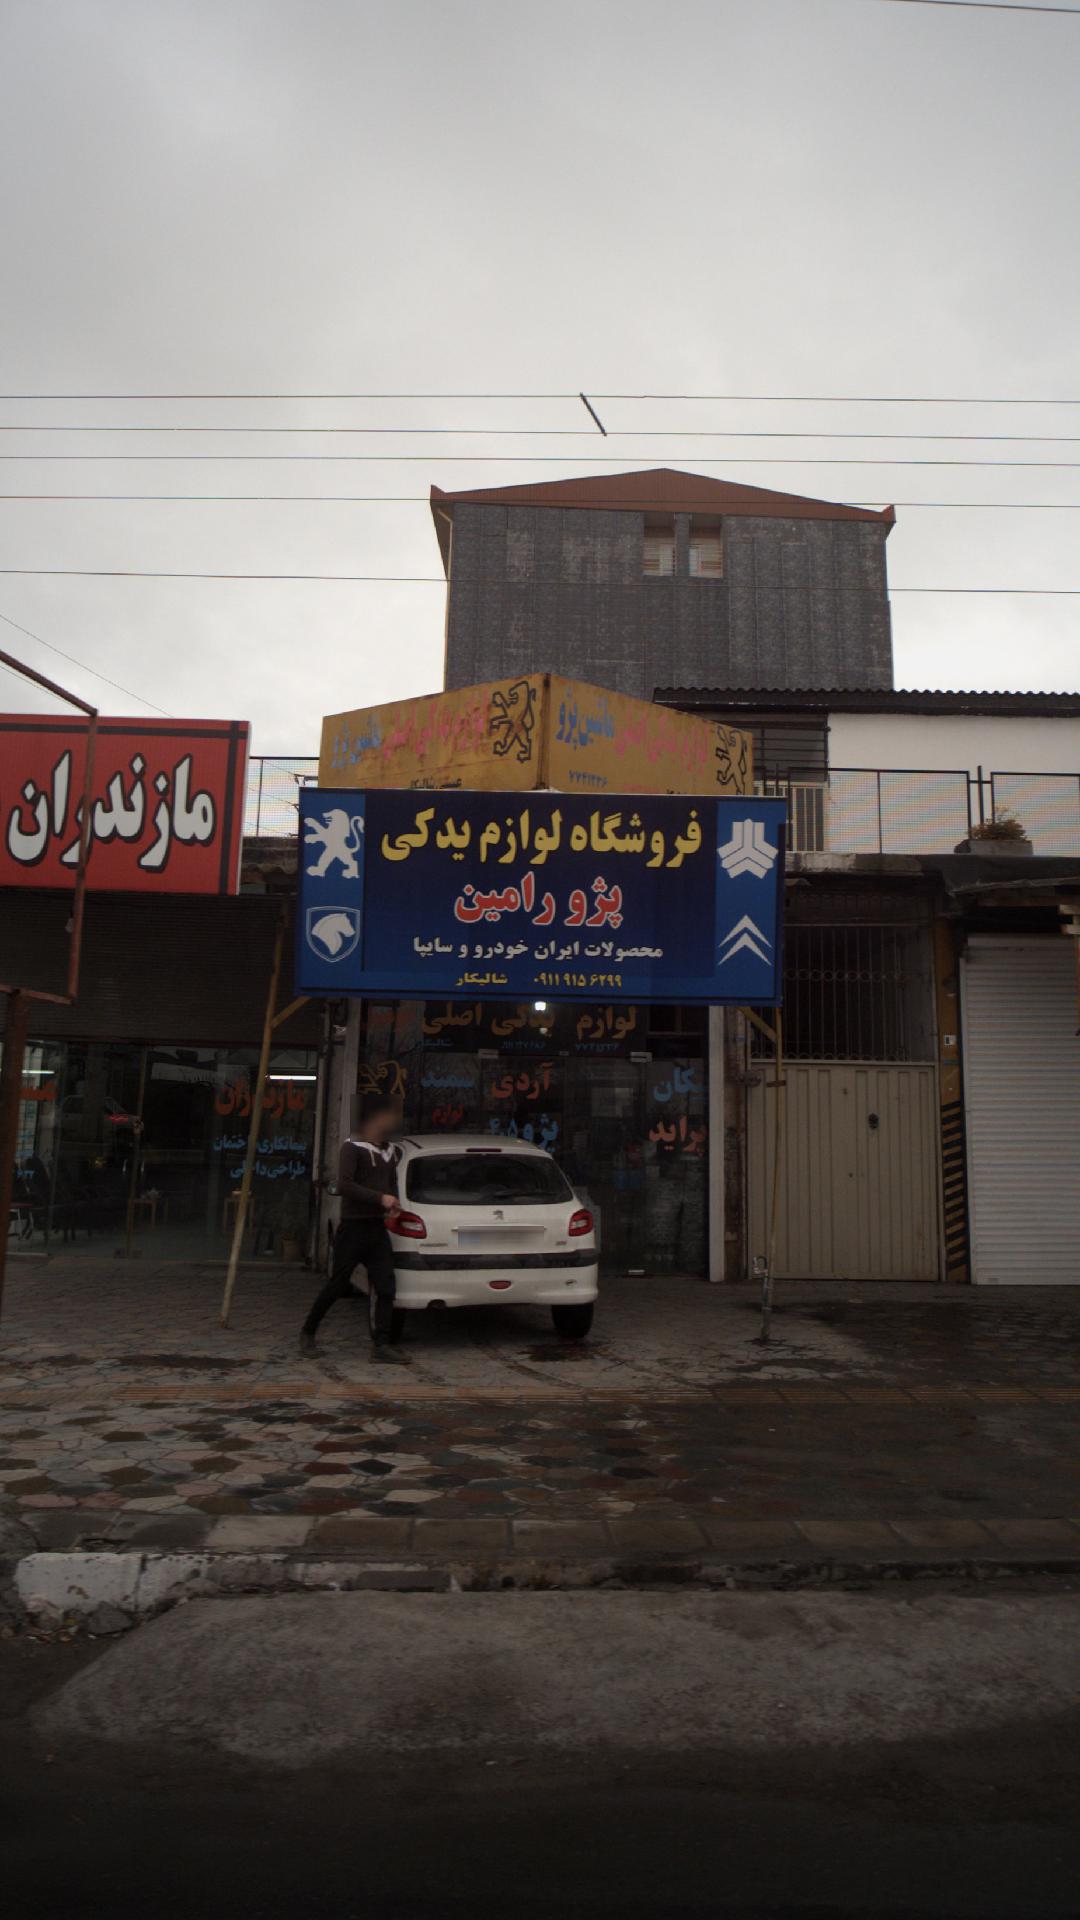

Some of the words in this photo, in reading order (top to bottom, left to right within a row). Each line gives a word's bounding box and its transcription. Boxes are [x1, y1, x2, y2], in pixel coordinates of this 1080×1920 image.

[7, 749, 218, 873] مازندران
[381, 807, 472, 861] یدکی
[479, 809, 563, 864] لوازم
[570, 808, 703, 868] فروشگاه
[453, 870, 556, 926] رامین
[564, 875, 624, 929] پژو
[412, 936, 453, 958] سایپا
[458, 942, 468, 959] و
[473, 938, 529, 960] خودرو
[533, 940, 580, 961] ایران
[583, 940, 664, 962] محصولات
[455, 973, 509, 987] شالیکار
[533, 972, 560, 987] ۰۹۱۱
[563, 972, 587, 987] ۹۱۵
[421, 1001, 483, 1036] اصلی
[576, 1004, 637, 1041] لوازم
[491, 1061, 554, 1100] آردی
[230, 1159, 265, 1179] دالی
